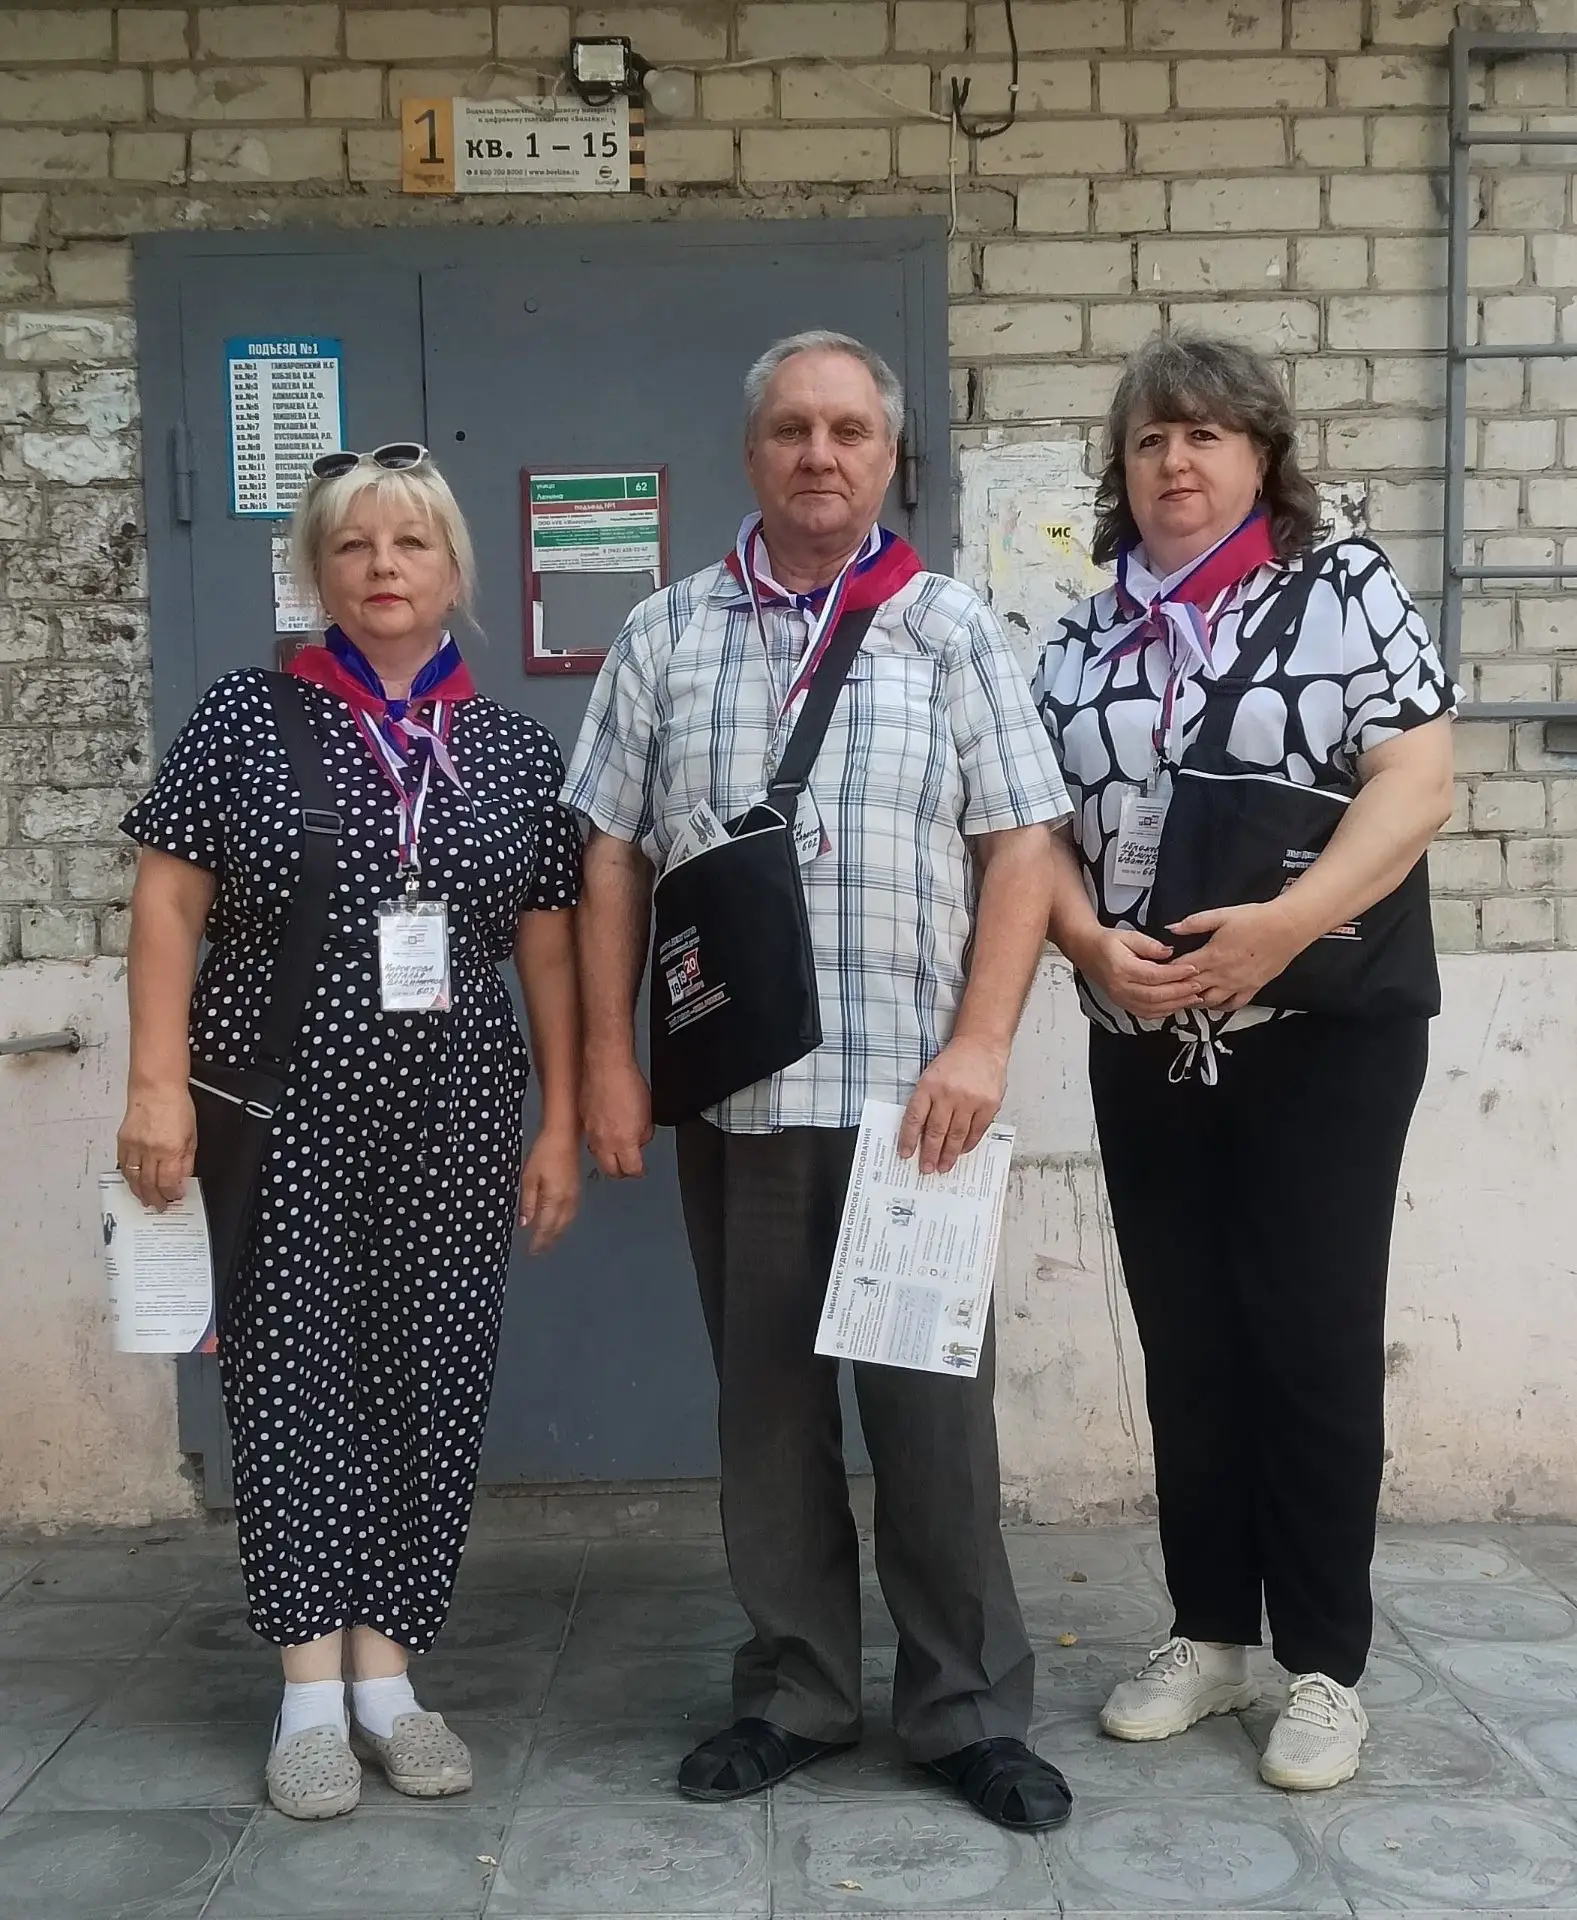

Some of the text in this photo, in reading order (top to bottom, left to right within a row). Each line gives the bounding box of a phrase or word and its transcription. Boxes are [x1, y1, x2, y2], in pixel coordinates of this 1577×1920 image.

[414, 109, 445, 164] 1
[466, 139, 513, 159] кв.
[526, 132, 540, 158] 1
[583, 132, 618, 158] 15
[248, 343, 319, 356] ПОДЪЕЗД №1
[635, 482, 648, 492] 62
[684, 957, 696, 974] 20
[678, 970, 688, 985] 19
[671, 982, 681, 997] 18
[827, 1127, 873, 1320] ВЫБИРАЙТЕ УДОБНЫЙ СПОСОБ ГОЛОСОВАНИЯ
